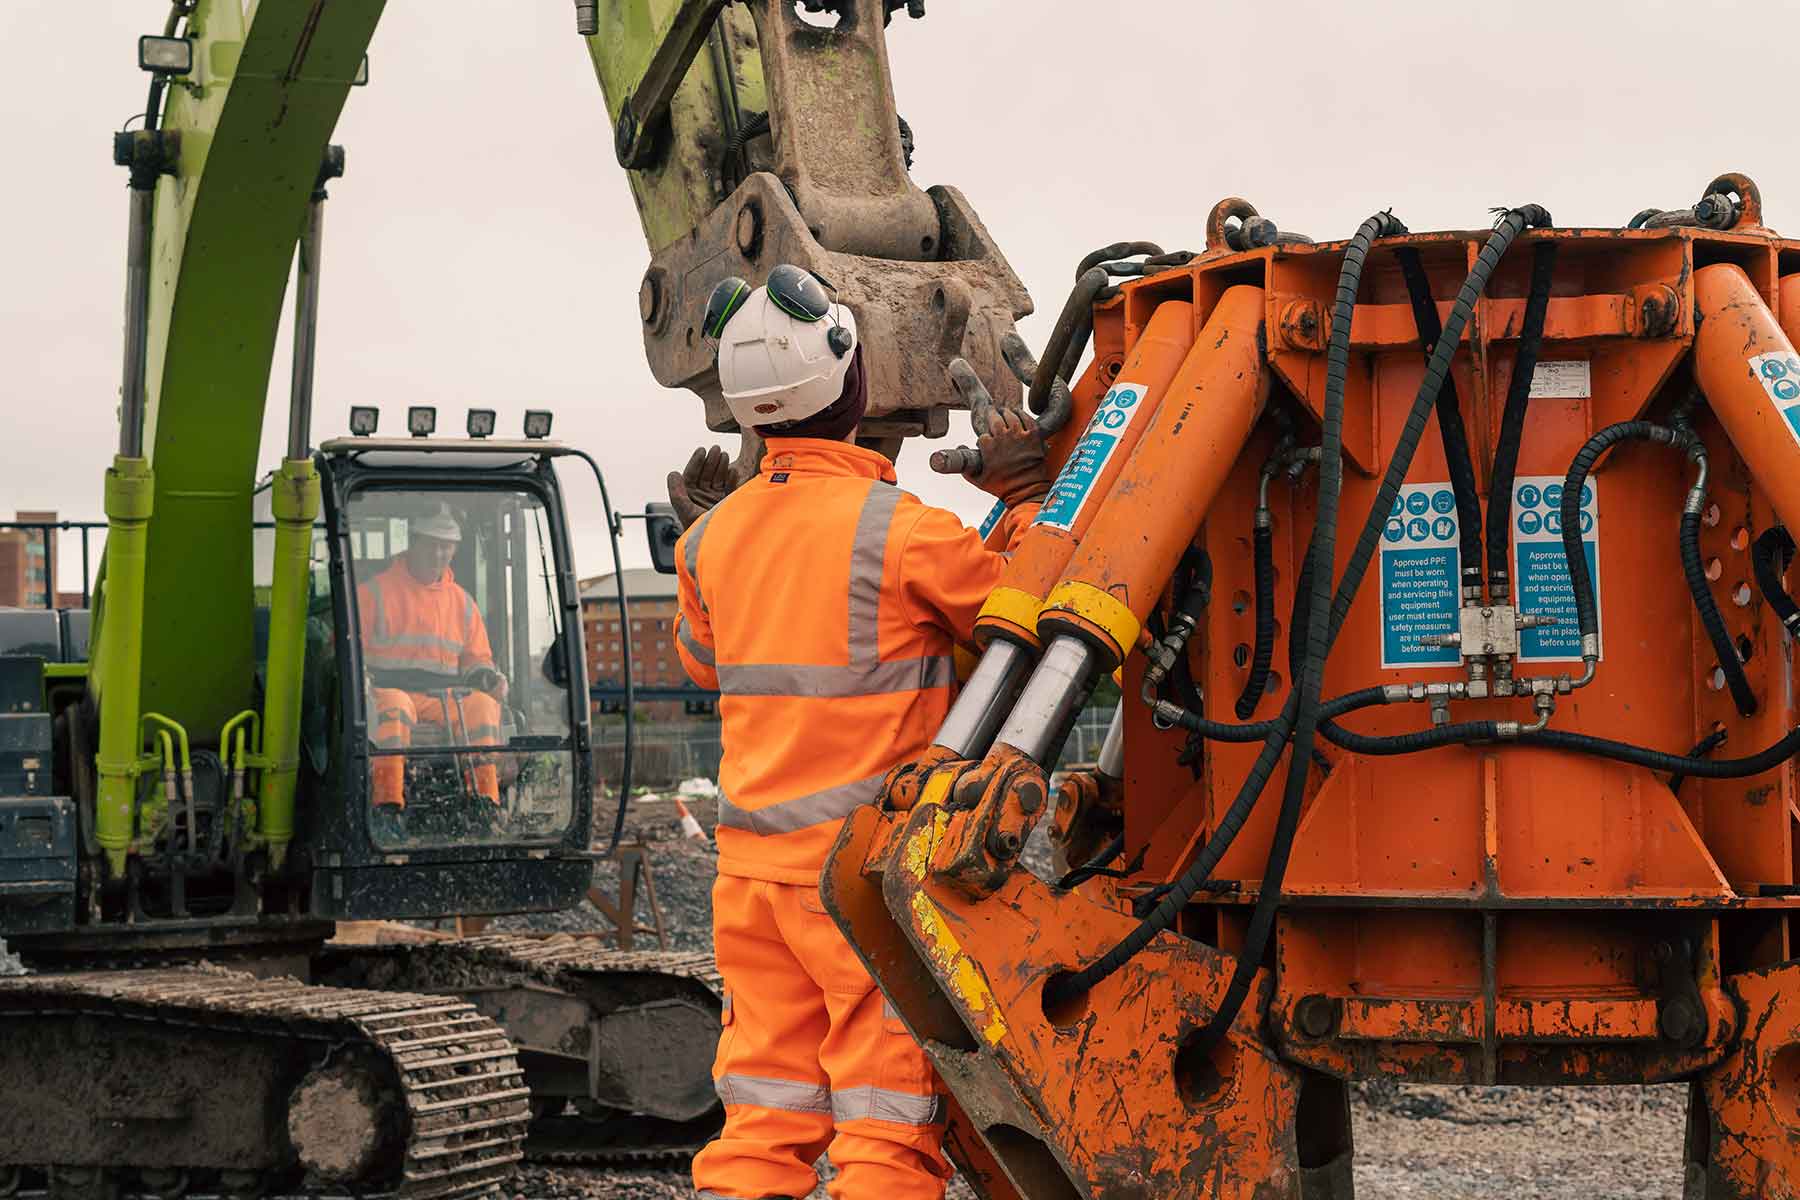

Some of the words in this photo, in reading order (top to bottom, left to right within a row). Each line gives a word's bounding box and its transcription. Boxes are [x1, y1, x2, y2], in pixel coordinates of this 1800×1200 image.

[1393, 557, 1429, 568] Approved
[1430, 556, 1447, 565] PPE
[1531, 562, 1551, 570] must
[1552, 561, 1562, 570] be
[1394, 569, 1413, 577] must
[1414, 569, 1424, 577] be
[1528, 573, 1549, 581] when
[1413, 579, 1449, 589] operating
[1524, 584, 1539, 592] and
[1388, 591, 1401, 599] and
[1403, 590, 1437, 600] servicing
[1438, 589, 1453, 597] this
[1538, 595, 1576, 605] equipmen
[1400, 600, 1440, 611] equipment
[1544, 605, 1564, 614] must
[1406, 612, 1425, 620] must
[1391, 623, 1413, 633] safety
[1414, 623, 1451, 631] measures
[1551, 627, 1560, 636] in
[1413, 634, 1420, 642] in
[1540, 638, 1565, 647] before
[1401, 644, 1425, 653] before
